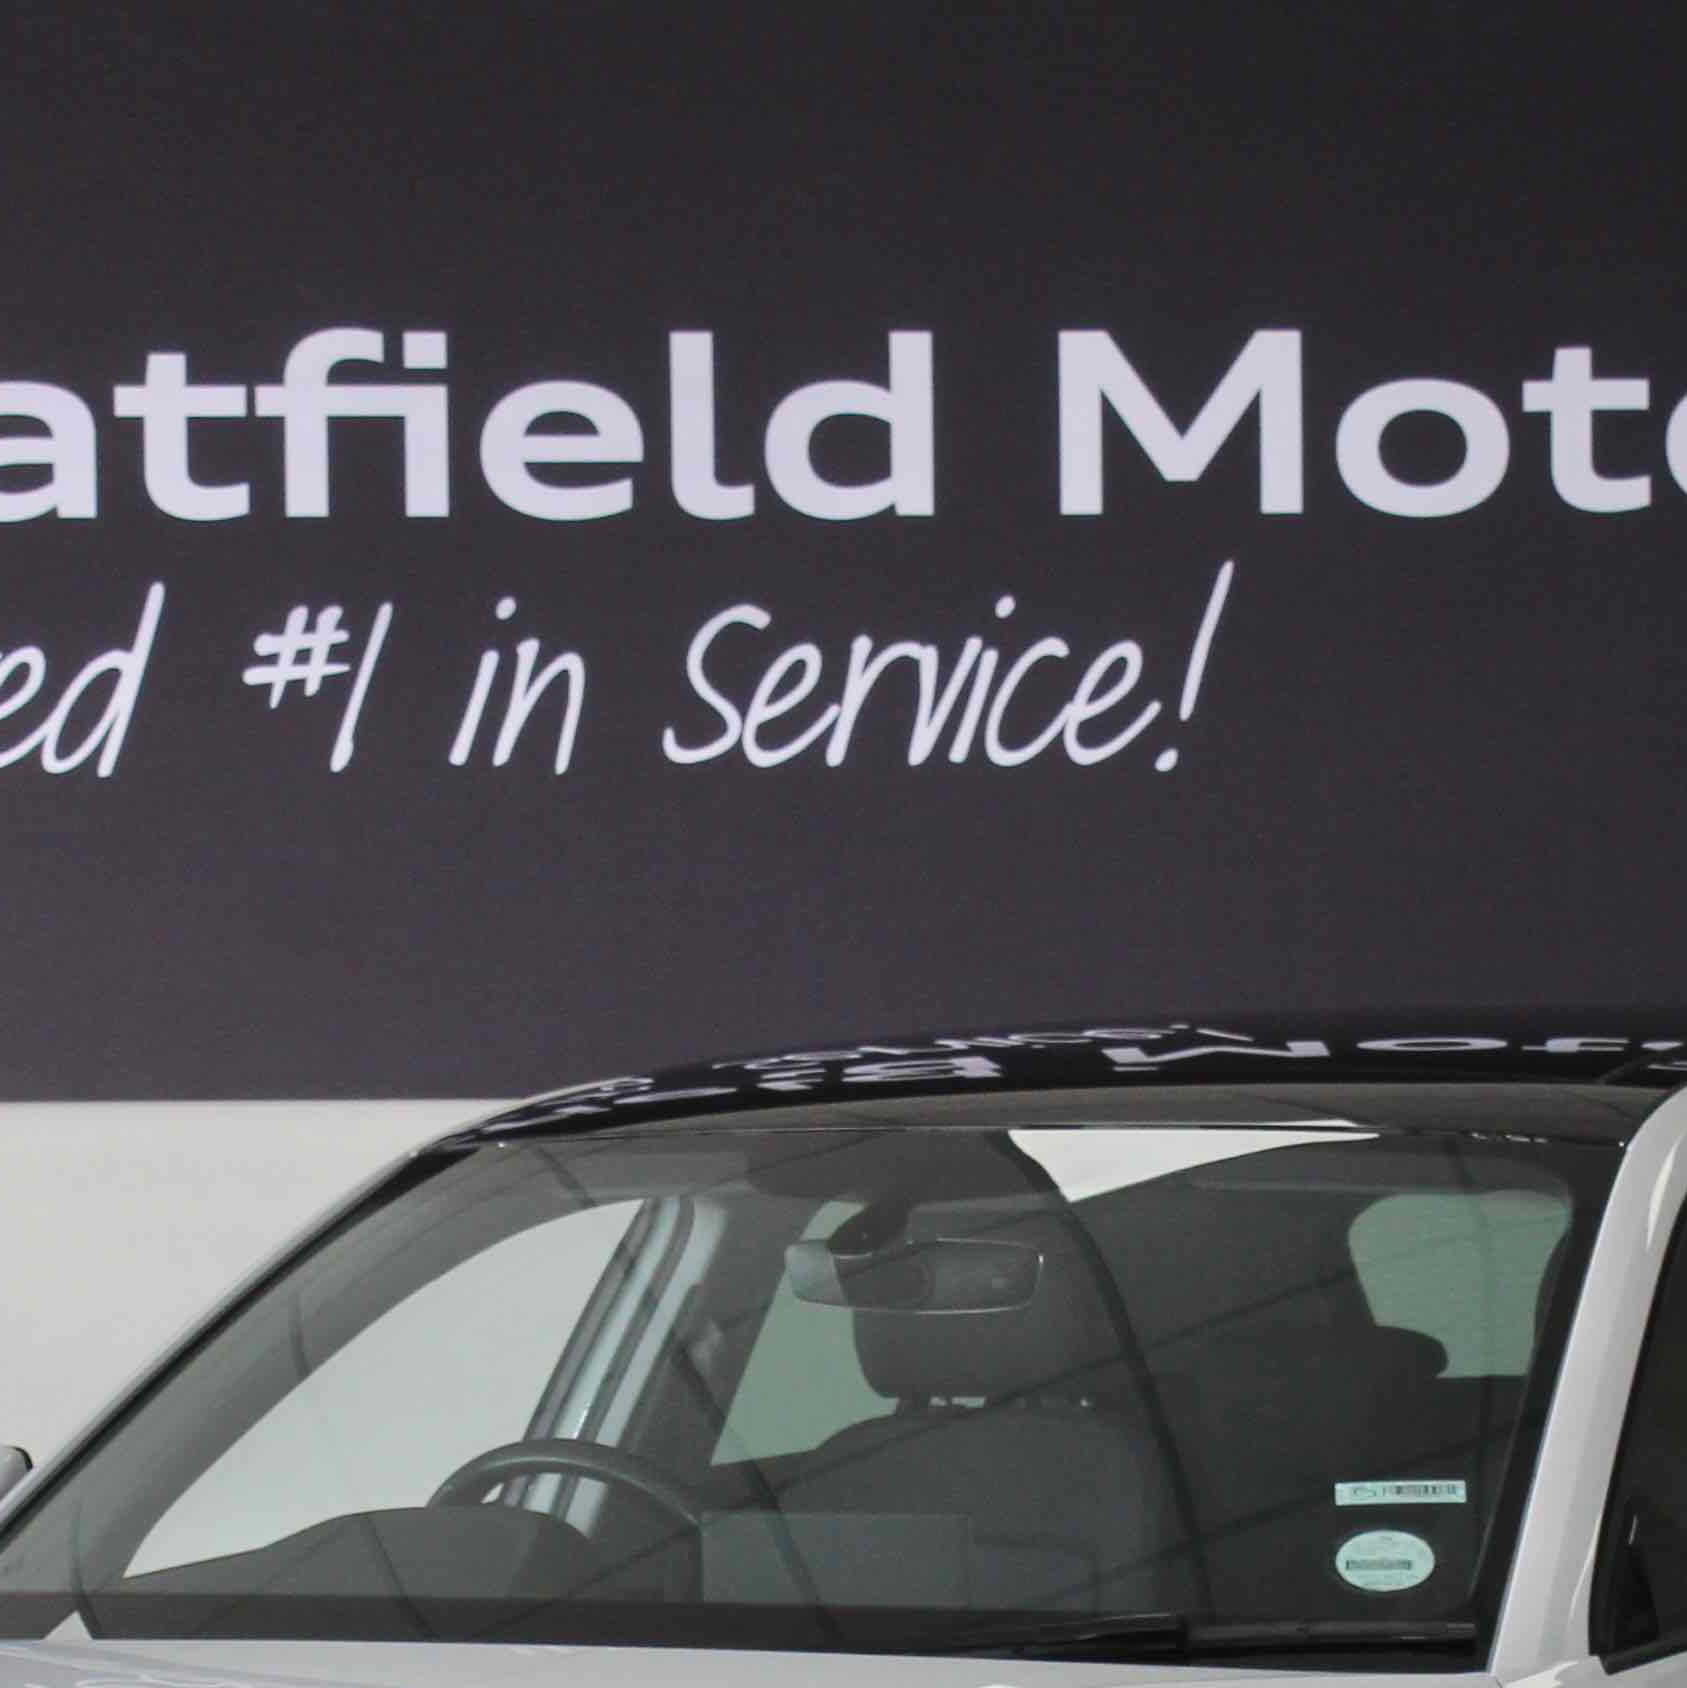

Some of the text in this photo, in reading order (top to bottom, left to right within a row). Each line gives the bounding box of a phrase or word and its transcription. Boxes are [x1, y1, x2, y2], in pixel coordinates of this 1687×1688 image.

[242, 602, 393, 773] #1
[448, 597, 586, 775] in
[662, 561, 1234, 772] Service!
